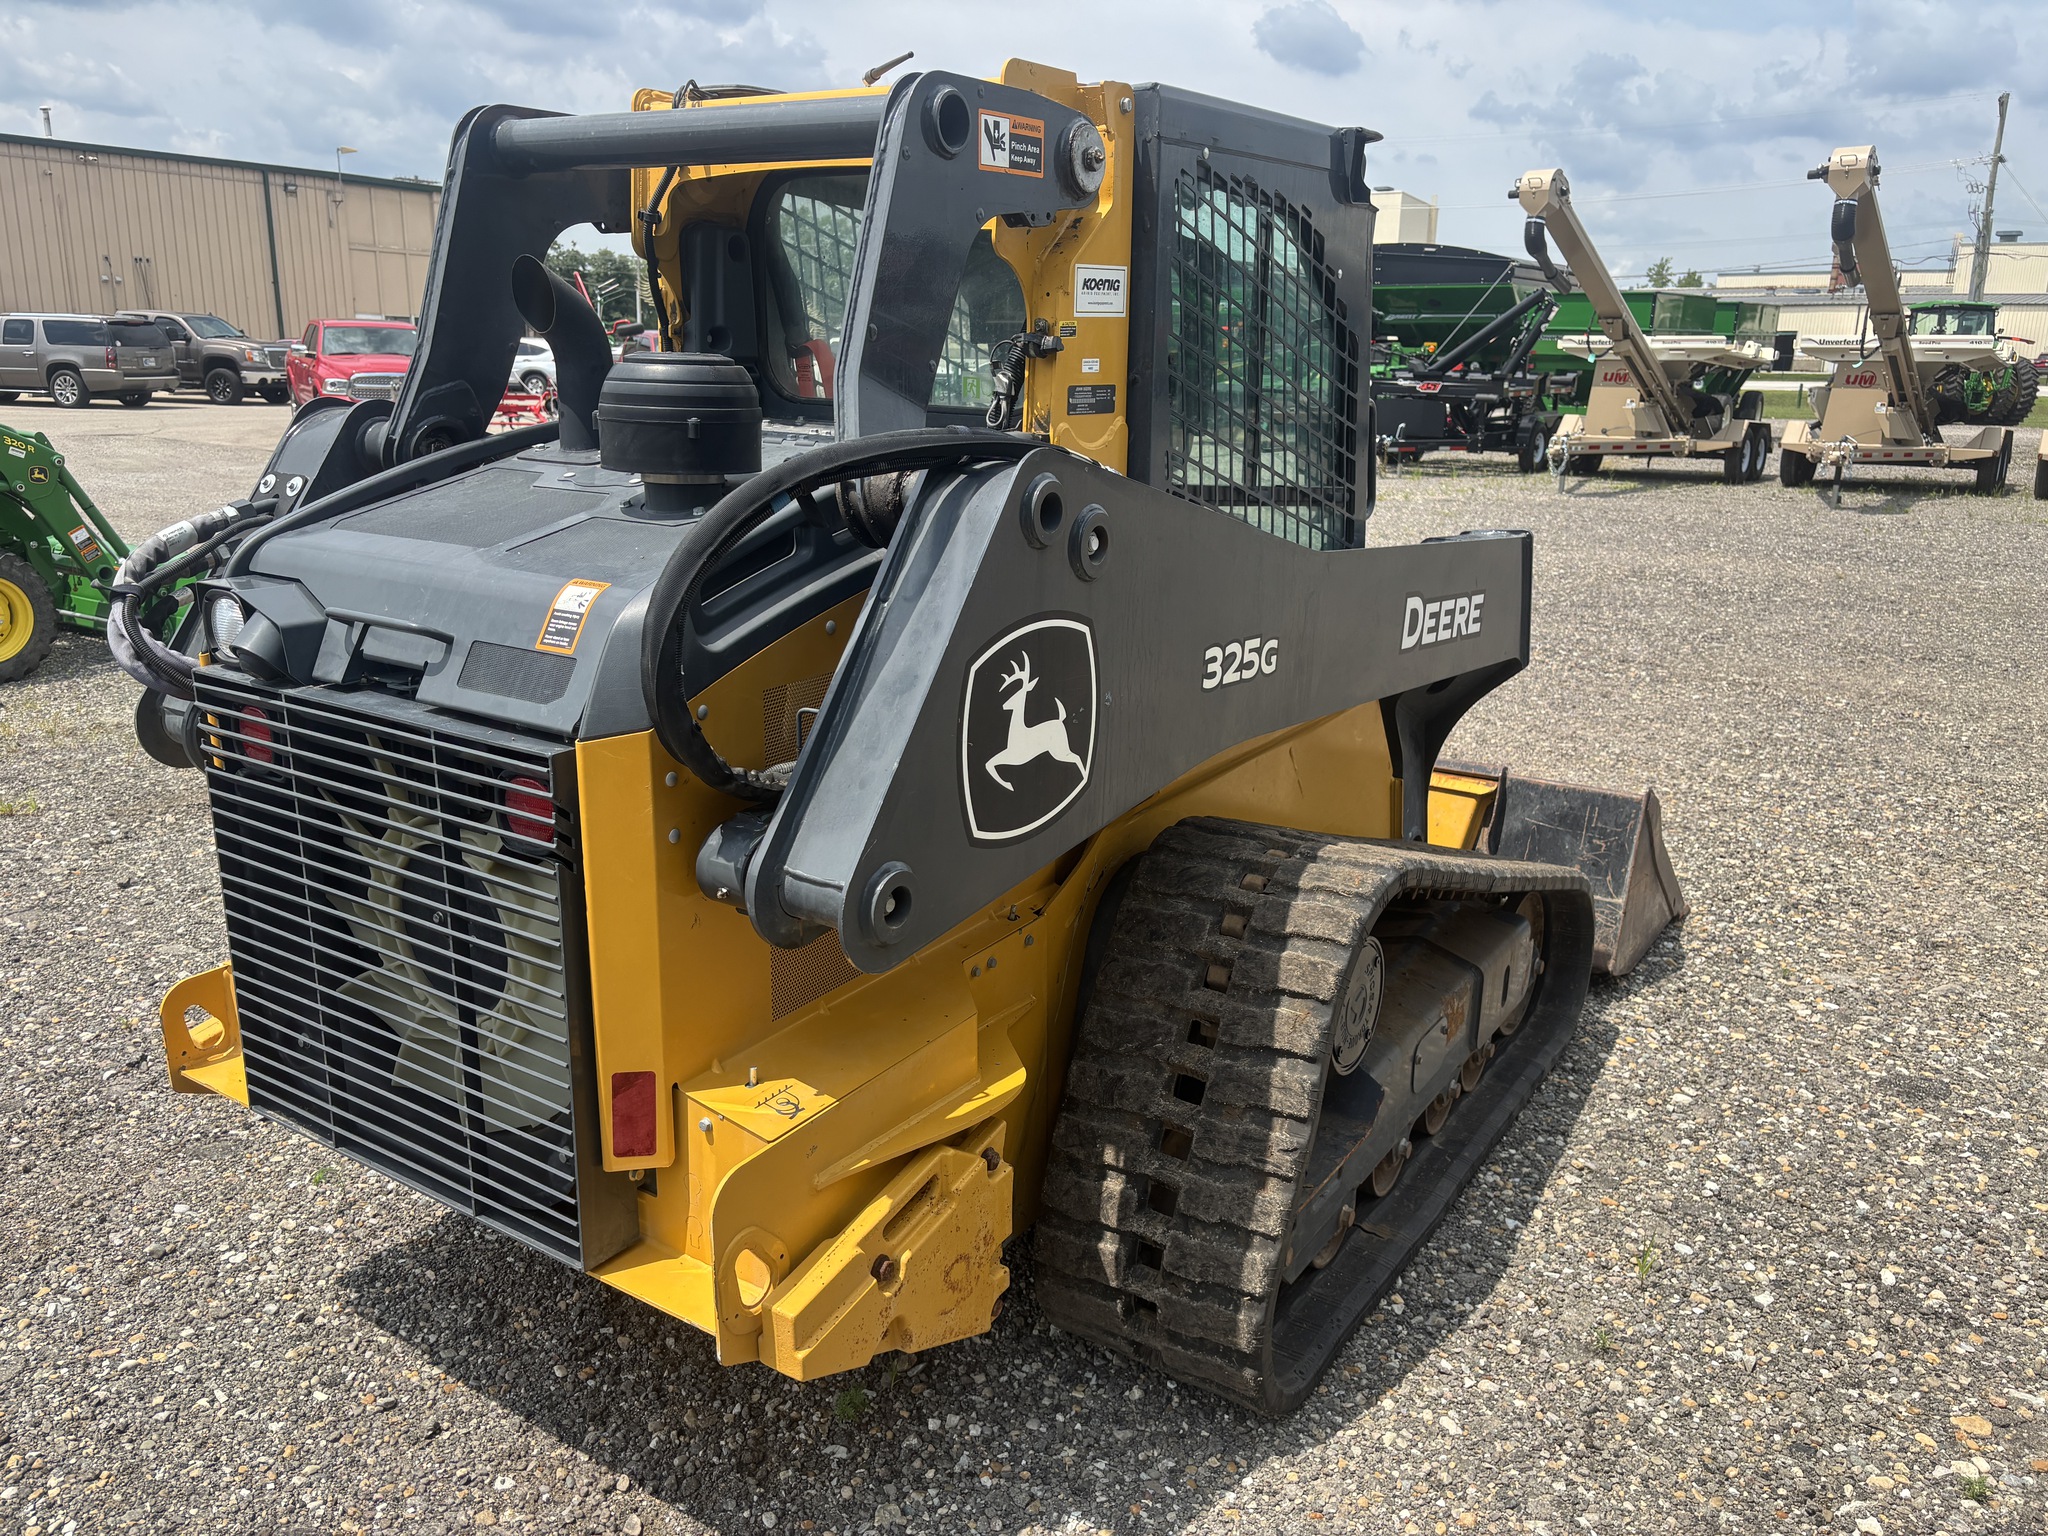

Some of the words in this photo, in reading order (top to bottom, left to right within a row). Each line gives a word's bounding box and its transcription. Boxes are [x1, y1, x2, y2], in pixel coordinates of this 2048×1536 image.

[1017, 121, 1042, 133] WARNING
[1011, 141, 1026, 151] Pinch
[1027, 144, 1040, 154] Area
[1011, 154, 1023, 163] Keep
[1024, 156, 1036, 166] Away
[1845, 373, 1876, 386] UM
[3, 435, 26, 449] 320
[27, 444, 35, 454] R
[1401, 593, 1485, 650] DEERE
[1202, 637, 1279, 689] 325G
